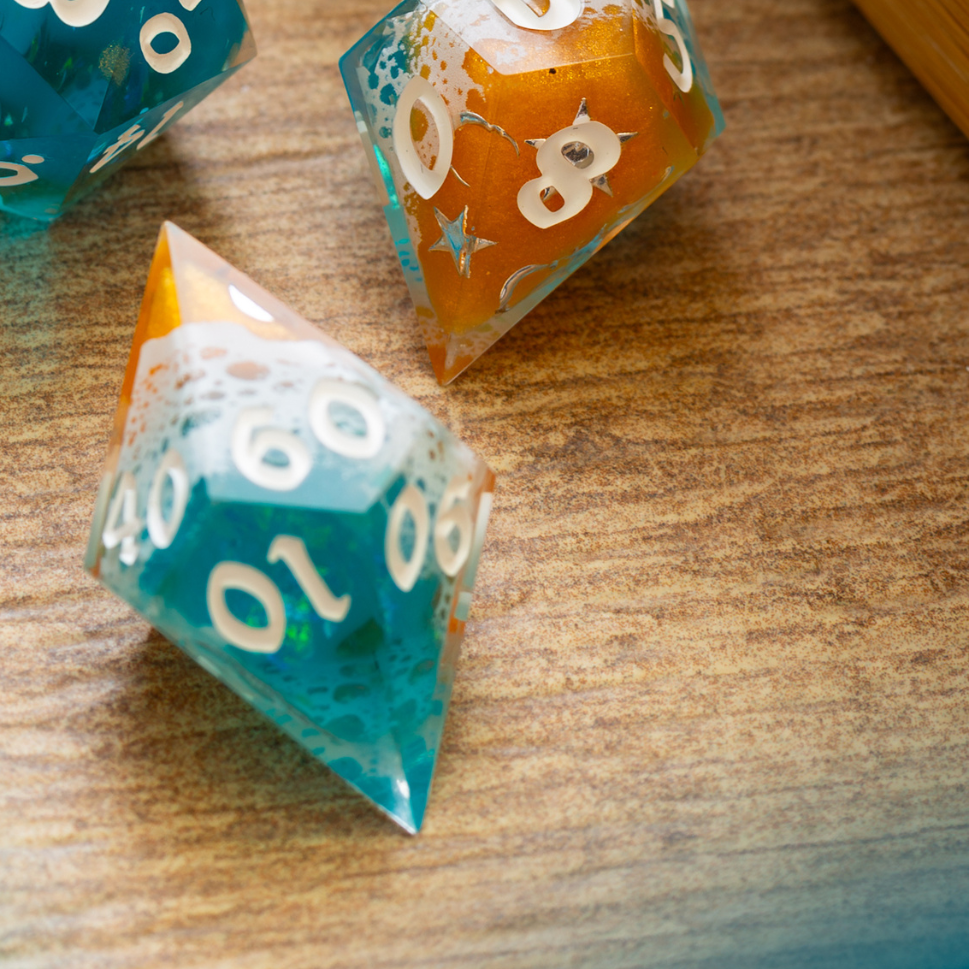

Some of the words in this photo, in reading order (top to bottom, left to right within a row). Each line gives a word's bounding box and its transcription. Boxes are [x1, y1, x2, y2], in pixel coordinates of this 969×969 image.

[393, 76, 454, 200] 0
[517, 120, 621, 229] 8
[231, 377, 386, 491] 60
[101, 448, 189, 565] 40
